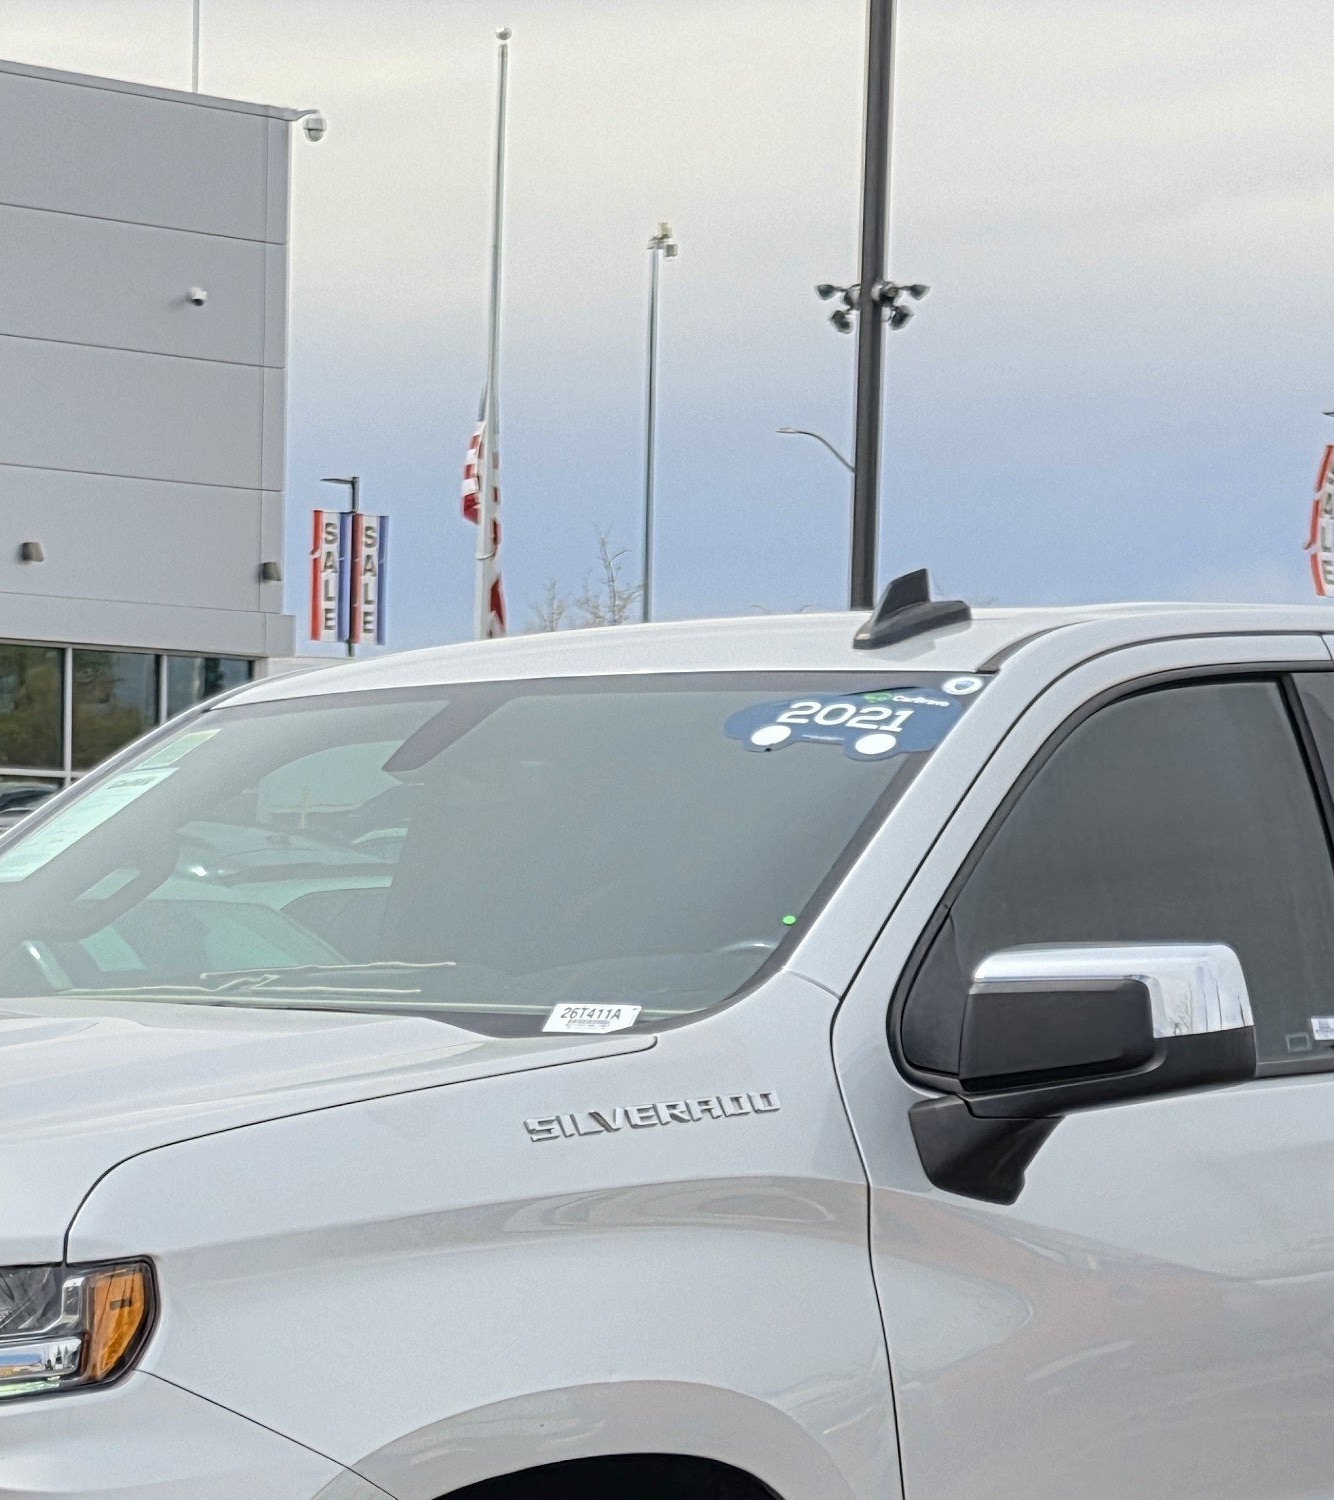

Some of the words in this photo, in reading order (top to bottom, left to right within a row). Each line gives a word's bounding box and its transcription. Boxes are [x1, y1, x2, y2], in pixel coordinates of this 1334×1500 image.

[320, 522, 339, 631] SALE
[361, 525, 378, 634] SALE
[776, 701, 915, 732] 2021
[560, 1007, 622, 1020] 26T411A
[523, 1090, 781, 1142] SILVERADO
